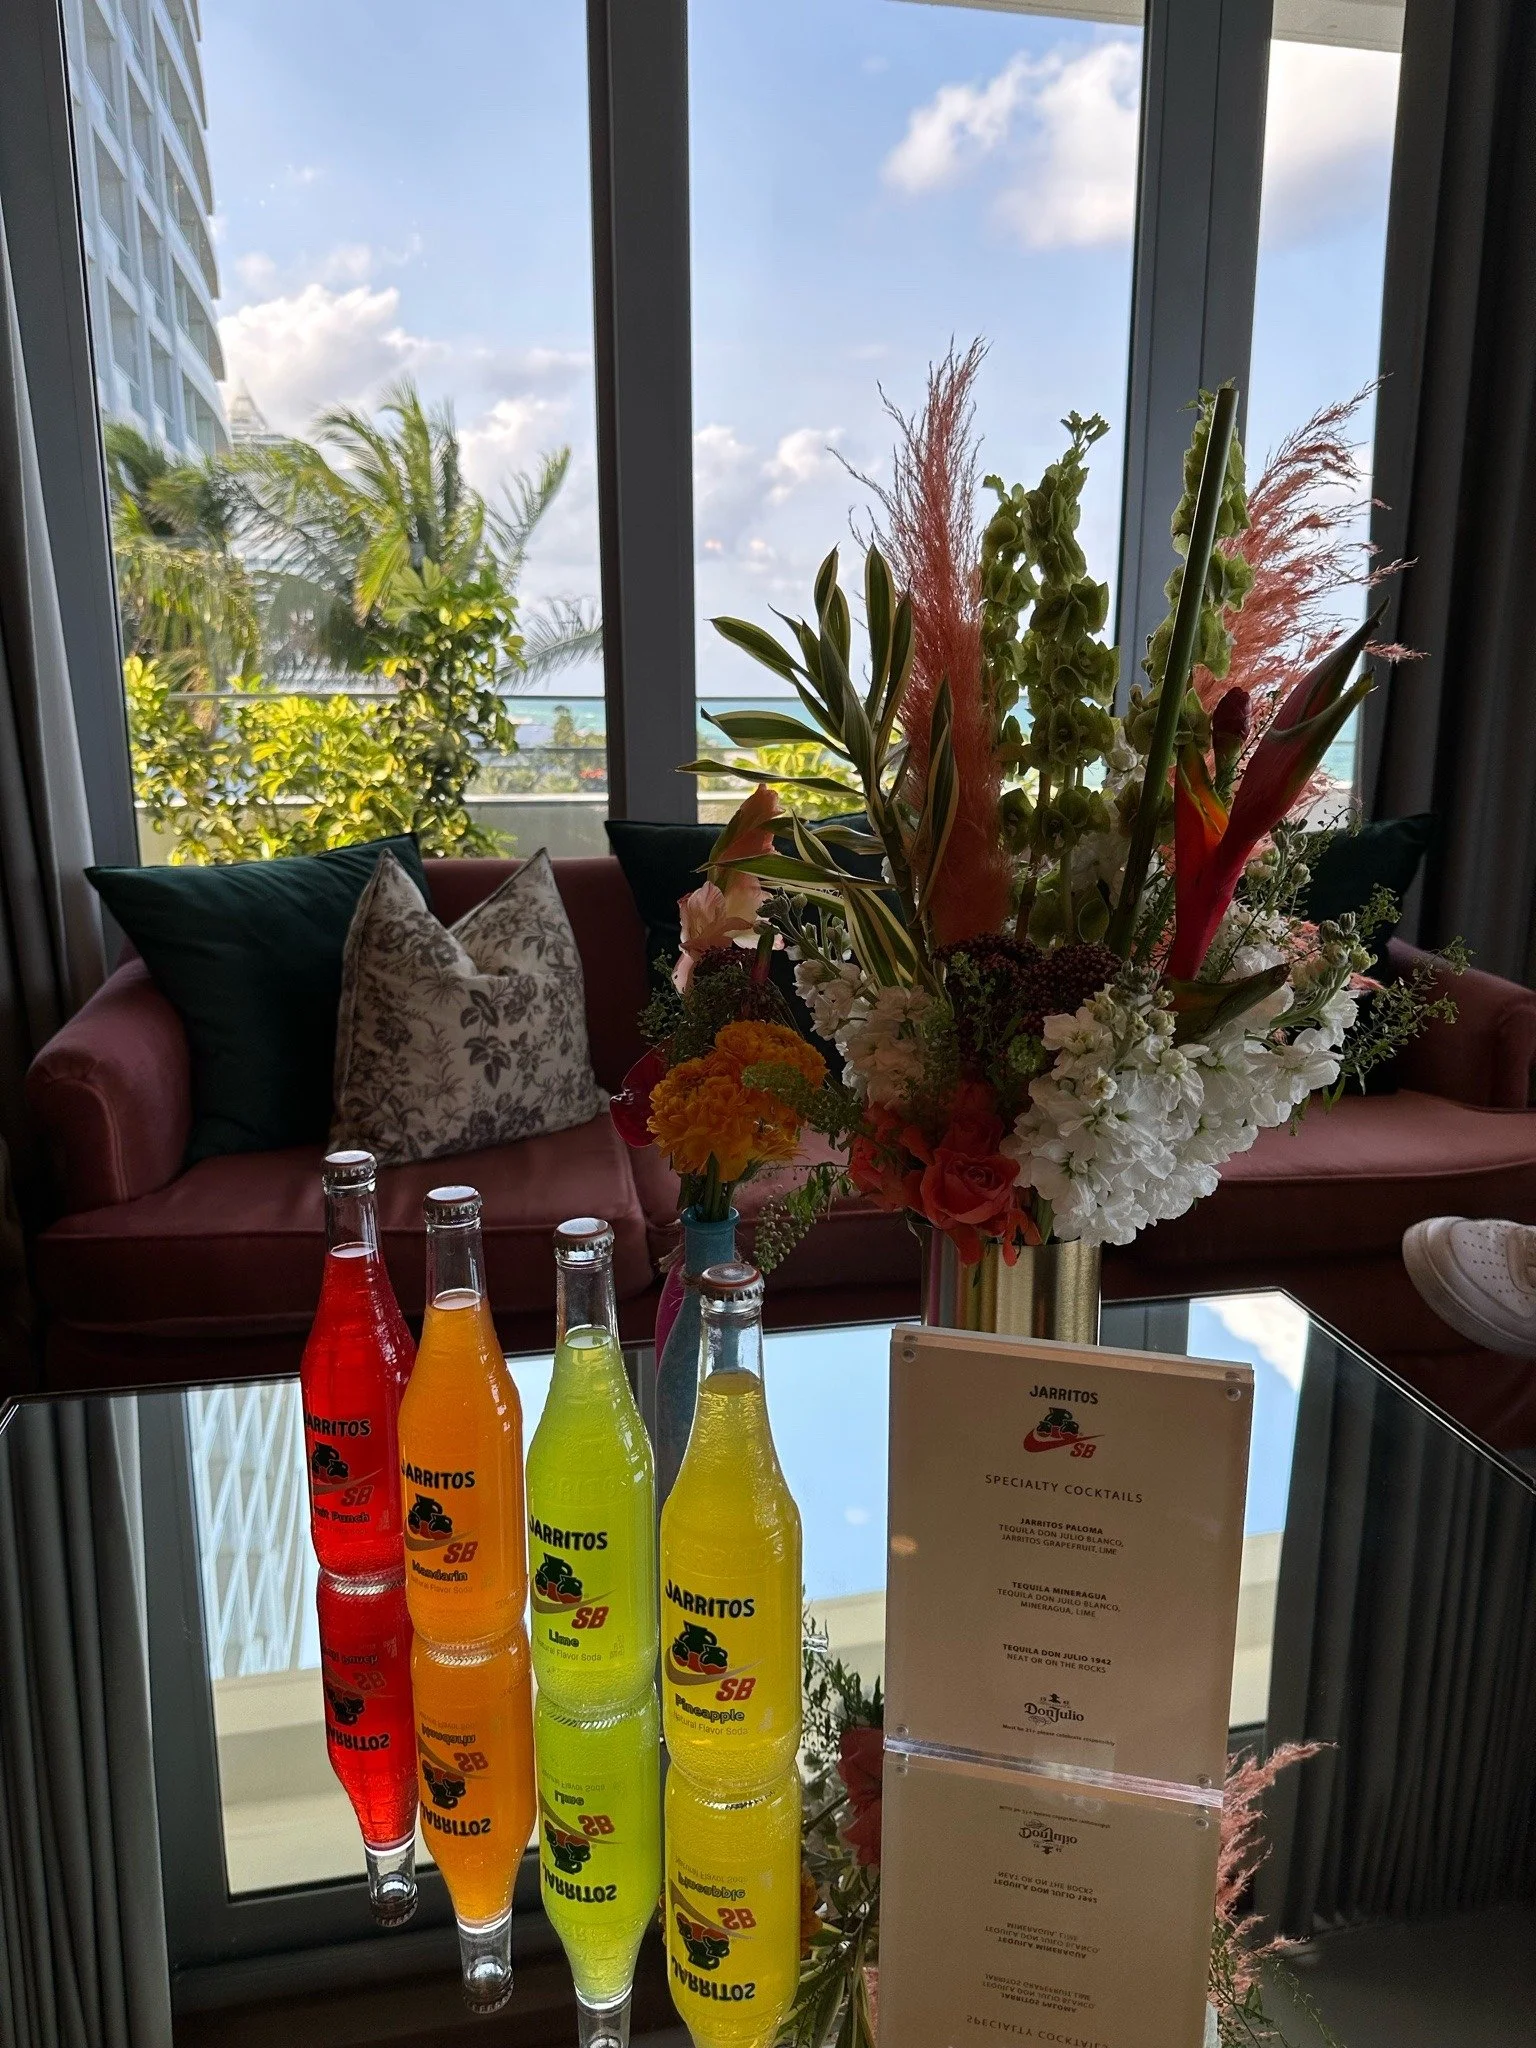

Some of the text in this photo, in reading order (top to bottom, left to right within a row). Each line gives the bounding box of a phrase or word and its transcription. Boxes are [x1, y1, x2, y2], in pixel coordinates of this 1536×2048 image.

[1029, 1386, 1098, 1404] JARRITOS
[304, 1412, 372, 1437] ARRITOS
[1070, 1443, 1096, 1458] SB
[342, 1485, 374, 1506] SB
[985, 1474, 1143, 1503] SPECIALTY COCKTAILS
[331, 1511, 370, 1523] Punch
[1021, 1518, 1103, 1534] JARRITOS PALOMA
[529, 1514, 608, 1551] JARRITOS
[999, 1524, 1124, 1548] TEQUILA DON JULIO BLANCO,
[443, 1541, 478, 1564] SB
[1002, 1534, 1117, 1555] JARRITOS GRAPEFRUIT, LIME
[412, 1559, 468, 1581] Mandarin
[430, 1582, 451, 1593] Flavor
[454, 1586, 473, 1594] Soda
[665, 1579, 755, 1618] JARRITOS
[1012, 1582, 1106, 1600] TEQUILA MINERAGUA
[998, 1589, 1033, 1599] TEQUILA
[1036, 1594, 1054, 1602] DON
[1084, 1601, 1120, 1612] BLANCO,
[1021, 1601, 1096, 1617] MINERAGUA, LIME
[571, 1606, 609, 1629] SB
[549, 1629, 580, 1647] Lime
[557, 1650, 578, 1660] Flavor
[581, 1653, 602, 1661] Soda
[1002, 1644, 1038, 1654] TEQUILA
[1042, 1649, 1060, 1658] DON
[1063, 1653, 1087, 1661] JULIO
[1007, 1653, 1028, 1662] NEAT
[1060, 1661, 1075, 1669] THE
[1078, 1664, 1106, 1673] ROCKS
[715, 1677, 757, 1702] SB
[675, 1693, 745, 1723] Pineapple
[673, 1711, 748, 1735] Natural Flavor Soda
